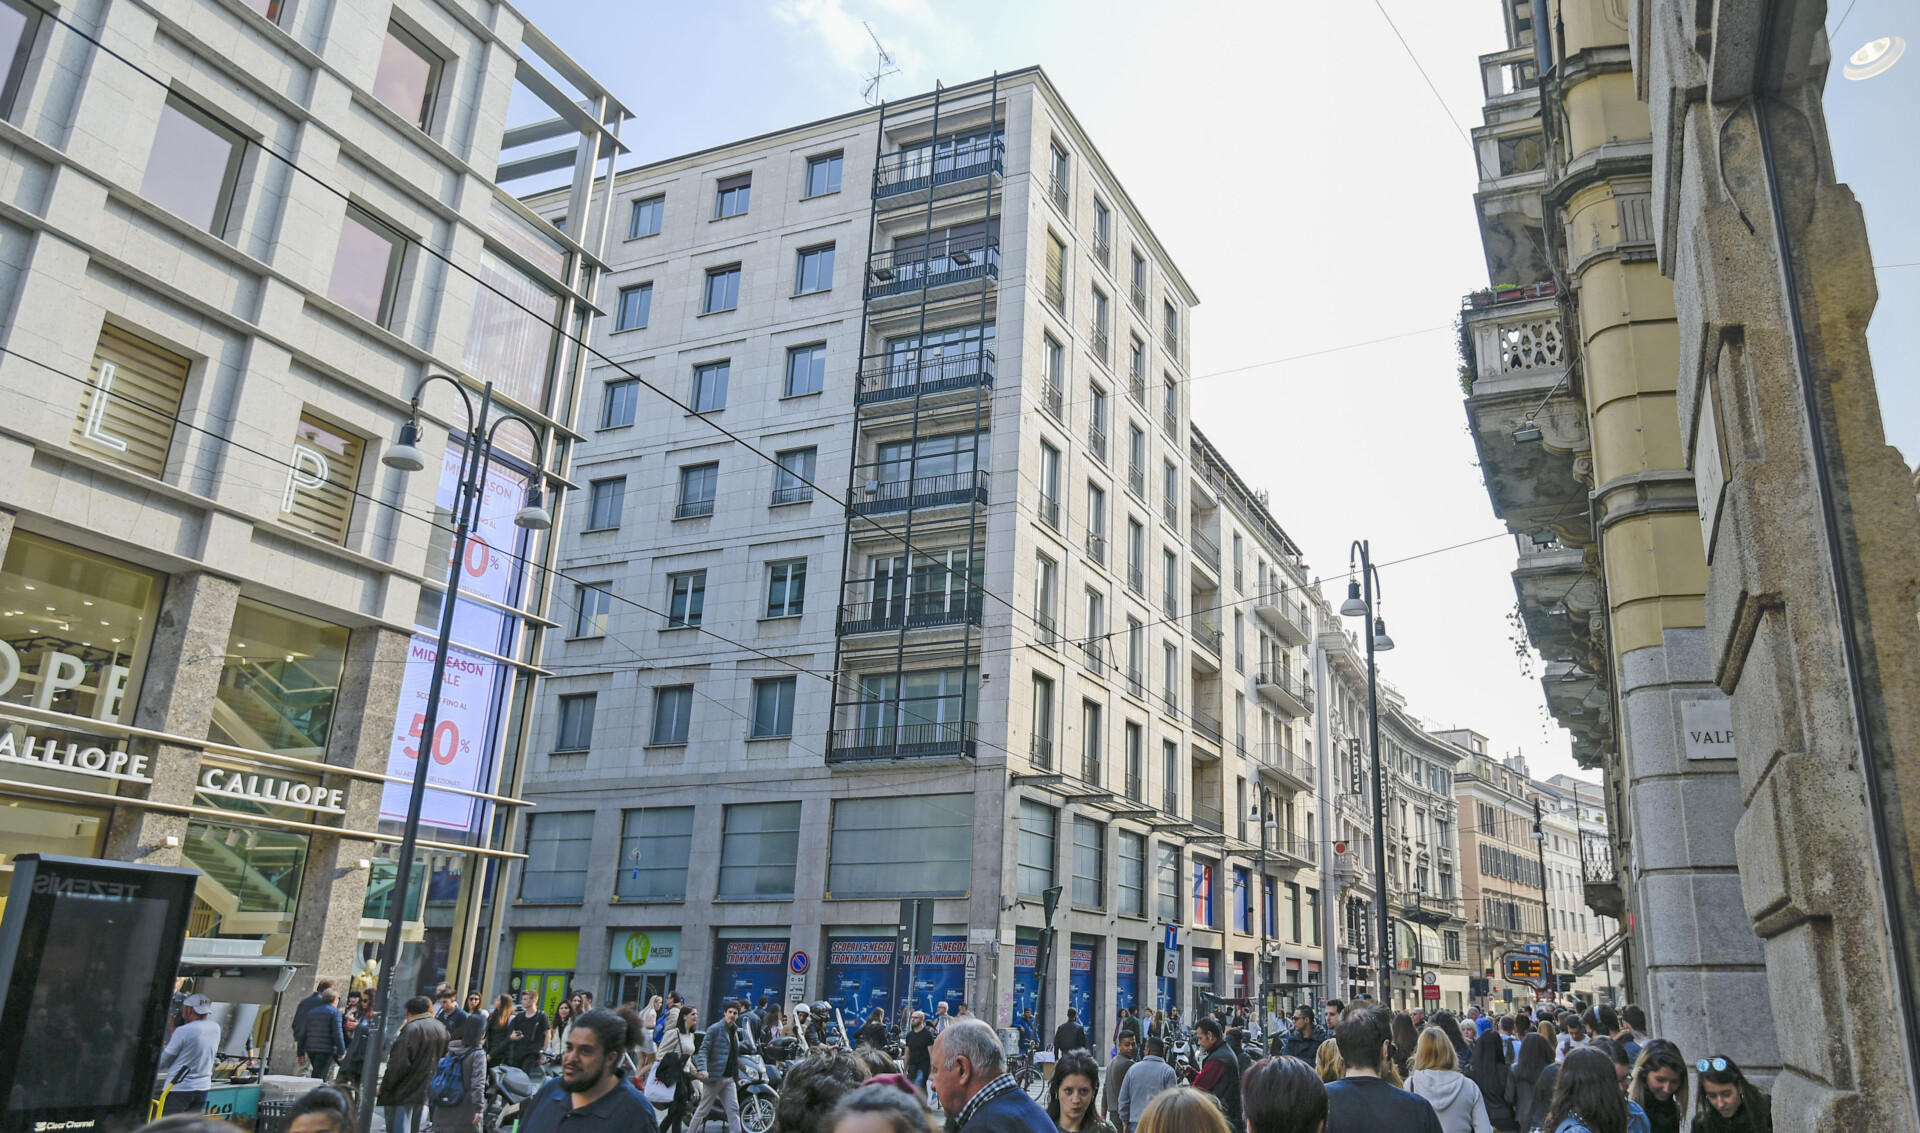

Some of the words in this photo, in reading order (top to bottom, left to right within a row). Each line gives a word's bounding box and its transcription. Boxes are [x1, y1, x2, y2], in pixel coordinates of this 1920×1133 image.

[412, 646, 438, 662] MID
[445, 656, 484, 676] EASON
[442, 672, 461, 687] ALE
[443, 698, 459, 709] FINO
[459, 703, 468, 711] AL
[1352, 741, 1360, 793] ALCOTT
[202, 768, 344, 809] CALLIOPE
[1359, 907, 1368, 964] ALCOTT
[727, 942, 752, 953] SCOPRI
[756, 943, 762, 953] 5
[762, 942, 787, 953] NEGOZI
[832, 941, 859, 952] SCOPRI
[863, 941, 868, 952] 5
[868, 941, 896, 952] NEGOZI
[936, 941, 942, 952] 5
[1386, 919, 1395, 968] ALCOTT
[754, 954, 783, 965] MILANO!
[831, 953, 855, 964] TRONY
[860, 953, 891, 964] MILANO!
[934, 953, 966, 965] MILANO!
[46, 1121, 66, 1130] Clear
[65, 1119, 95, 1129] Channel
